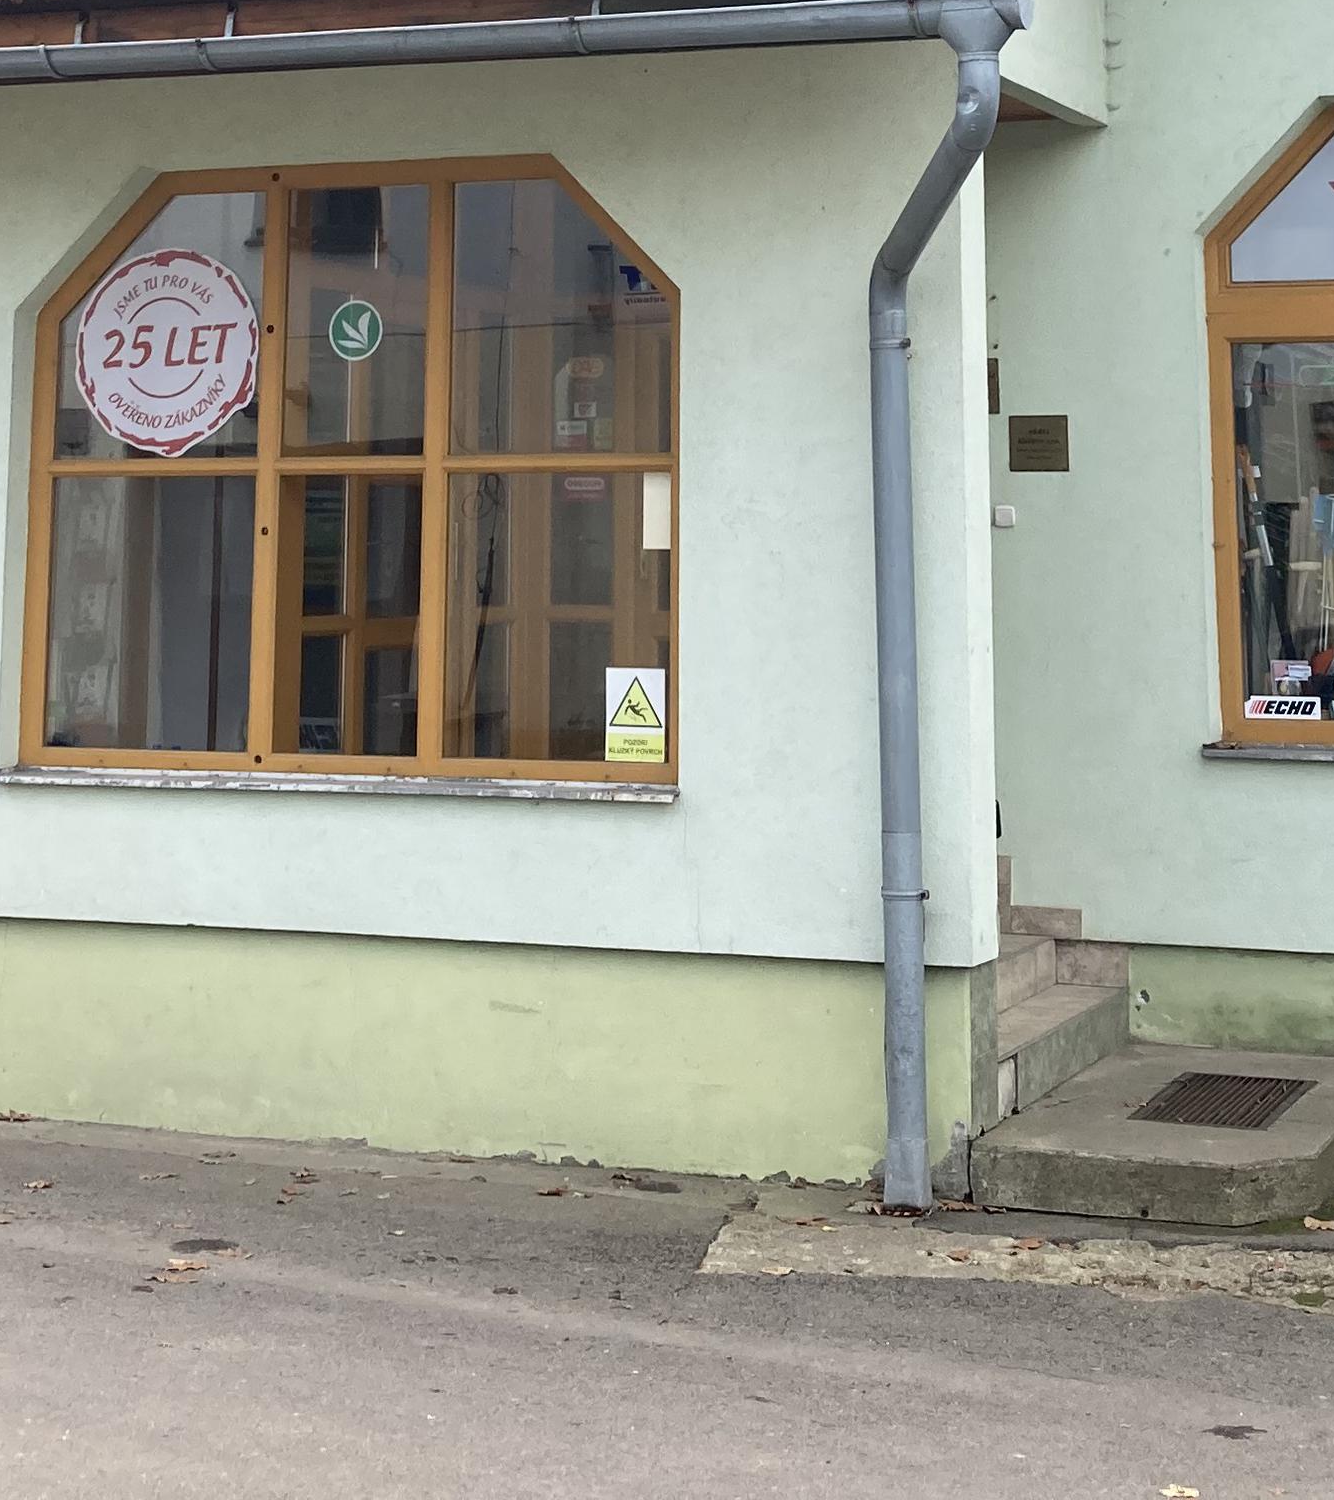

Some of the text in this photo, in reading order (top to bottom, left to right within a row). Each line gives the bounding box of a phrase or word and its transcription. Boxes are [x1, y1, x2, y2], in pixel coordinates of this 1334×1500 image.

[113, 274, 215, 320] JSME TU PRO VÁS
[102, 322, 239, 369] 25 LET
[108, 373, 227, 428] OVĚŘENO ZÁKAZNÍKY
[1267, 700, 1317, 715] ECHO
